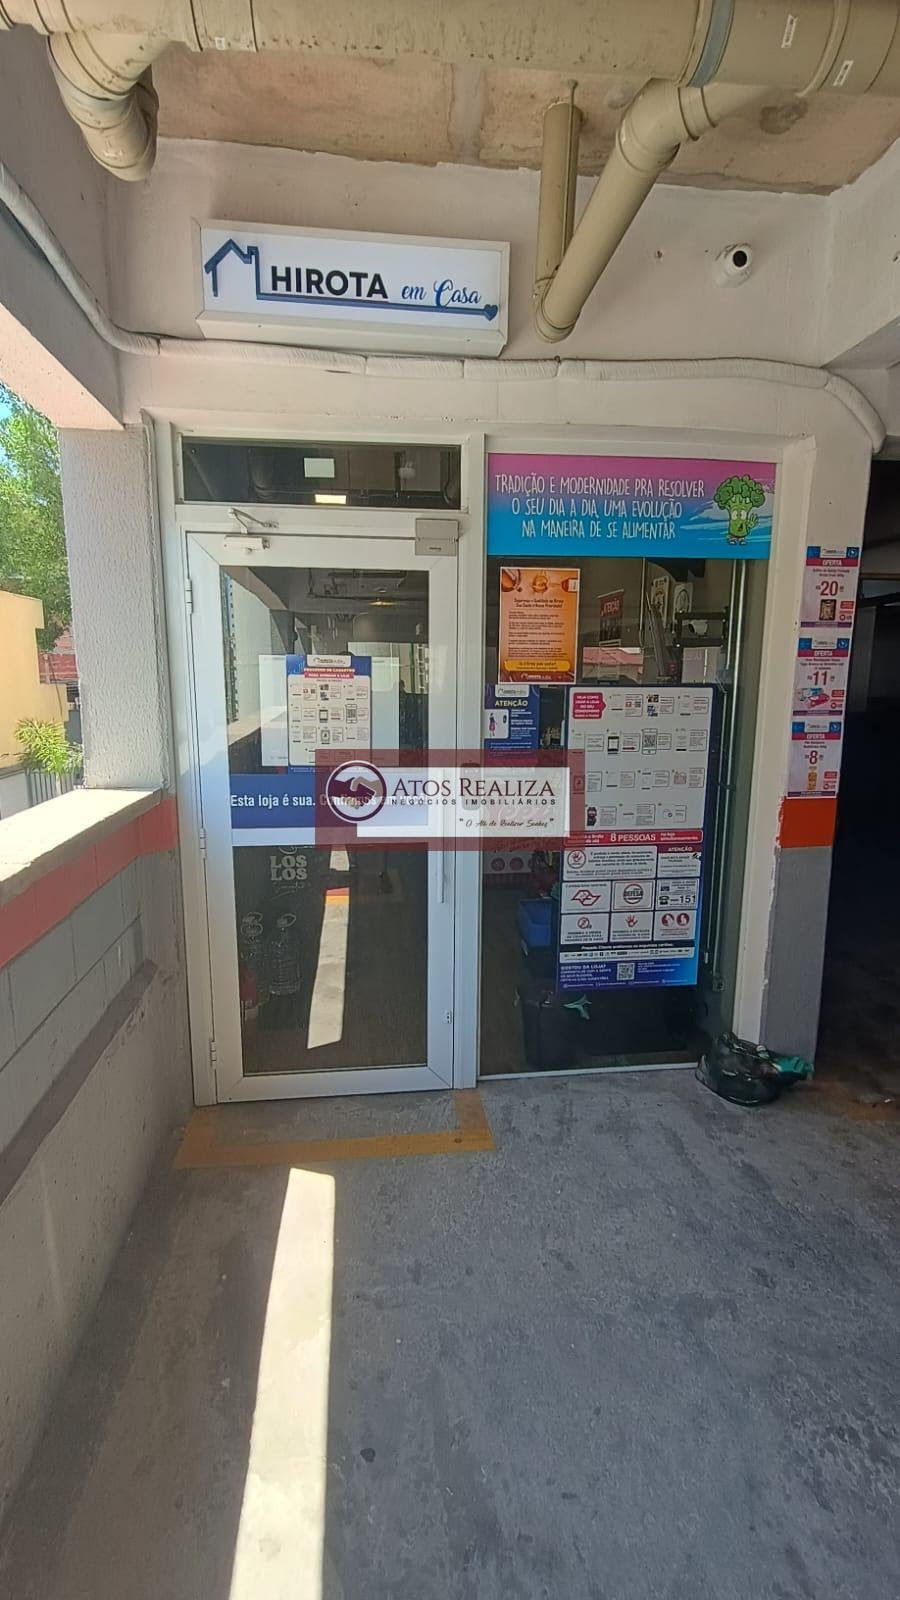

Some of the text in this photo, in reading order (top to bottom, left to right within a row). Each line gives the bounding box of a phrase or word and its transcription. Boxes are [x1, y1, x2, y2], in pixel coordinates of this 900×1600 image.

[271, 266, 481, 307] HIROTA em Casa
[495, 472, 705, 498] TRADIÇÃO E MODERNIDADE PRA RESOLVER
[511, 498, 520, 515] O
[524, 498, 544, 515] SEU
[550, 499, 565, 516] DIA
[570, 499, 577, 516] A
[604, 500, 627, 517] UMA
[632, 499, 682, 521] EVOLUÇÃO
[522, 521, 675, 540] NA MANEIRA DE SE ALIMENTAR
[820, 581, 838, 596] 20
[813, 671, 827, 685] 11
[495, 699, 528, 707] ATENÇÃO
[809, 750, 818, 764] 8
[231, 794, 254, 806] Esta
[258, 794, 279, 809] loja
[282, 794, 289, 806] é
[292, 796, 316, 806] sua.
[610, 832, 617, 842] 8
[618, 832, 656, 841] PESSOAS
[270, 856, 307, 868] LOS
[271, 868, 307, 880] LOS
[679, 895, 696, 904] 151
